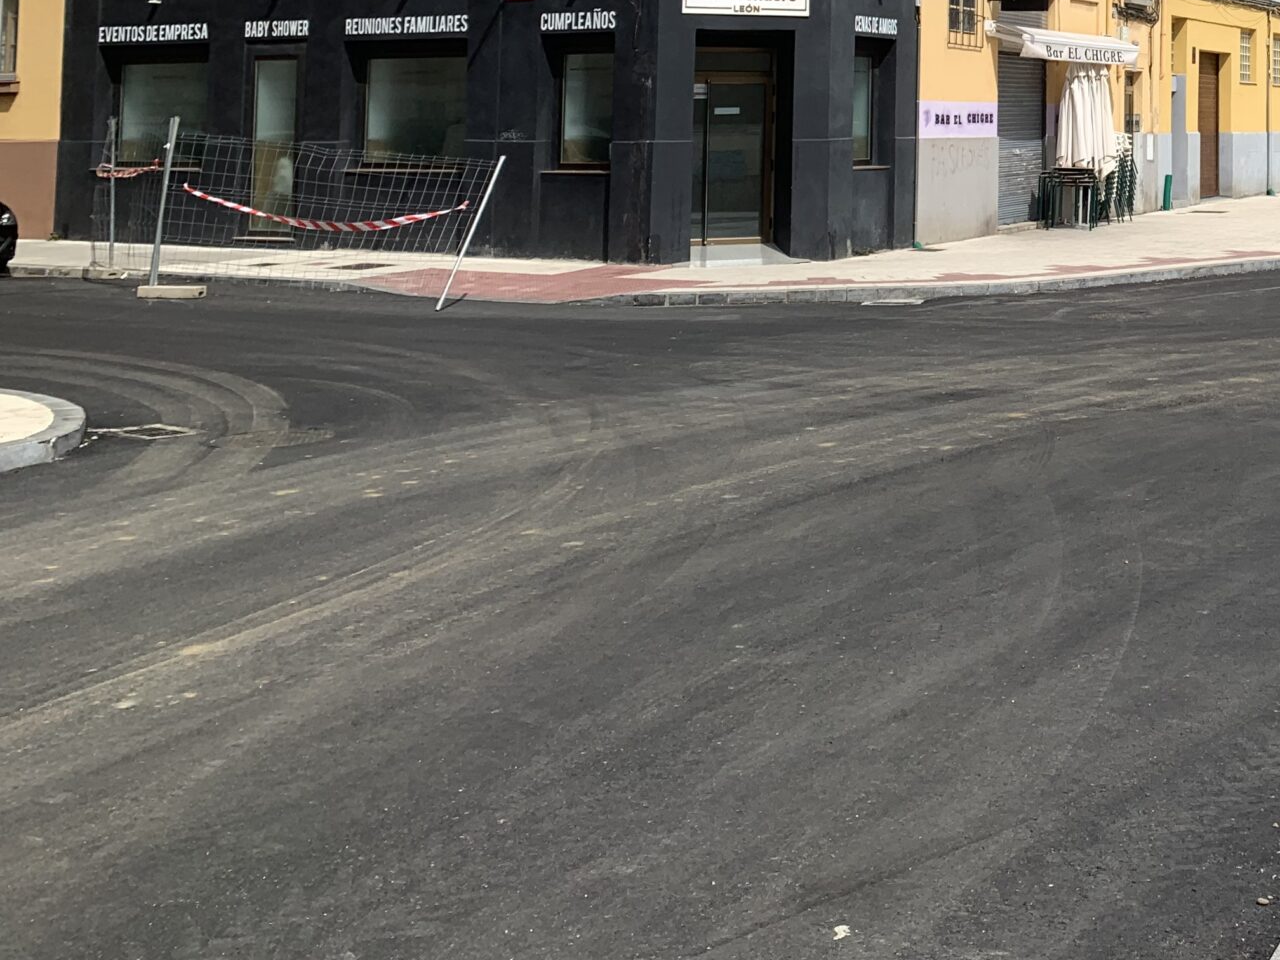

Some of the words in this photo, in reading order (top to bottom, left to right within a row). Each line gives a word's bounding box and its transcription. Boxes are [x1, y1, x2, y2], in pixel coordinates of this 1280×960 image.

[733, 4, 760, 13] LEÓN
[244, 20, 270, 38] BABY
[271, 19, 309, 36] SHOWER
[345, 17, 402, 35] REUNIONES
[403, 14, 468, 33] FAMILIARES
[540, 7, 616, 31] CUMPLEAÑOS
[99, 26, 145, 42] EVENTOS
[145, 25, 158, 41] DE
[159, 23, 208, 40] EMPRESA
[1046, 45, 1064, 58] Bar
[1068, 47, 1081, 60] EL
[1084, 48, 1125, 63] CHIGRE
[935, 113, 951, 125] BAR
[953, 115, 963, 125] EL
[967, 113, 995, 124] CHIGRE
